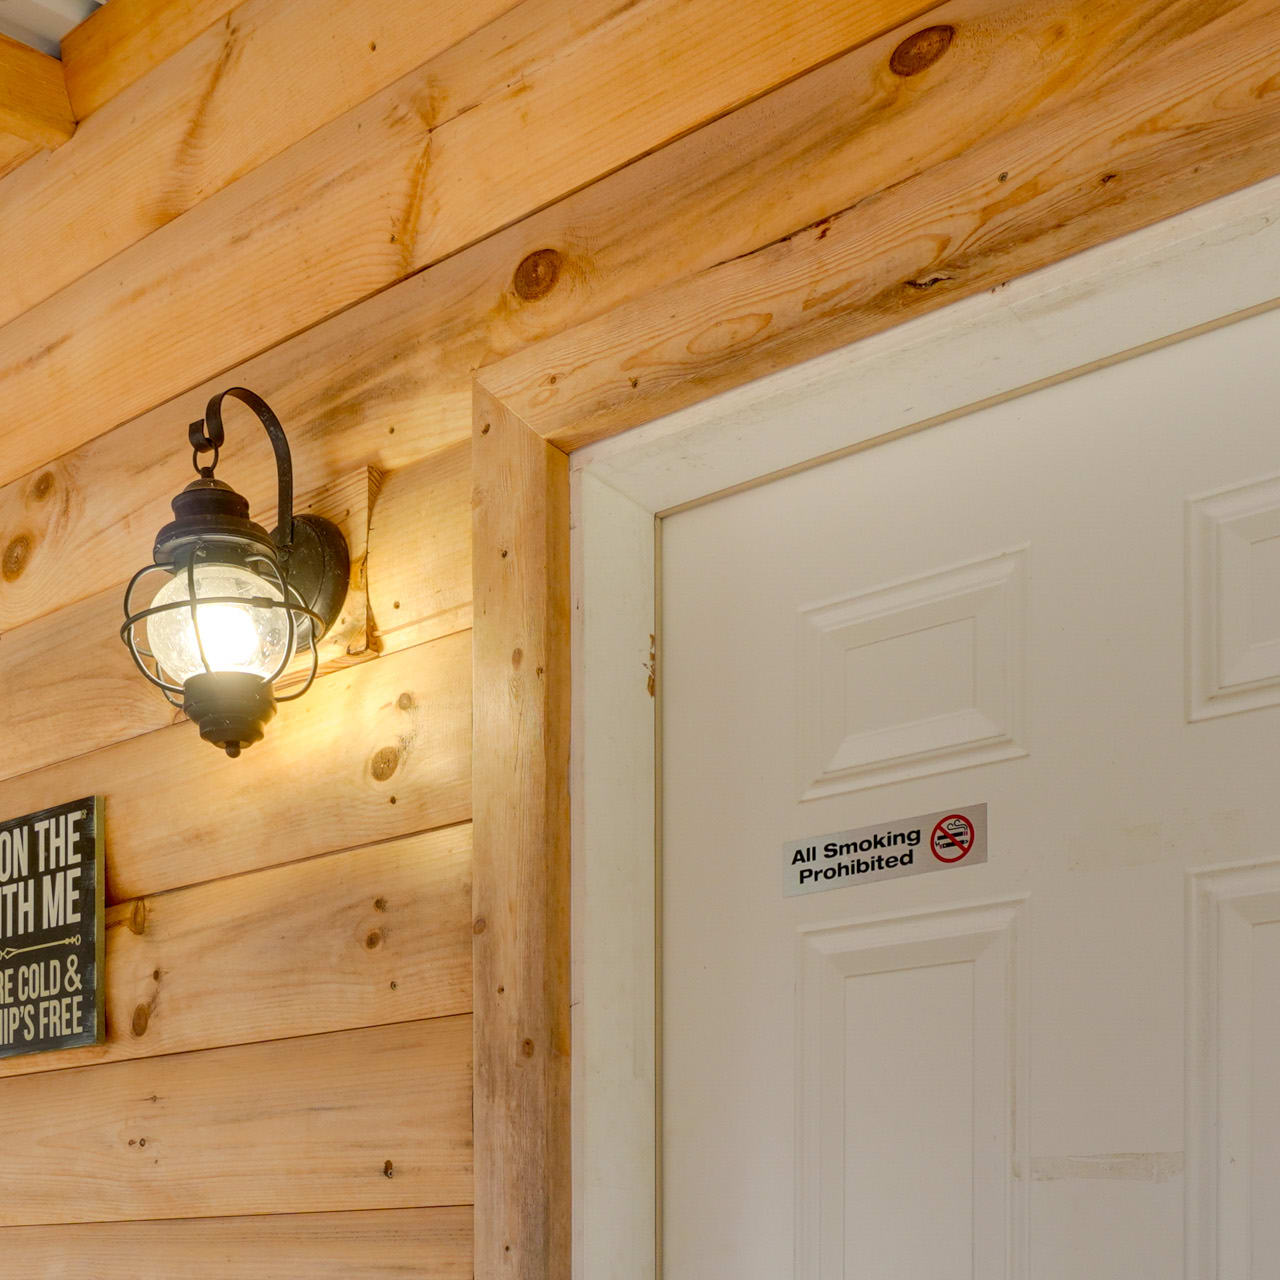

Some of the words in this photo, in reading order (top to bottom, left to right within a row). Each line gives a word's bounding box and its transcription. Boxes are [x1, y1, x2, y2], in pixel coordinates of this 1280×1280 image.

[34, 811, 82, 872] THE
[791, 846, 816, 865] All
[824, 829, 921, 859] Smoking
[799, 849, 914, 884] Prohibited
[42, 867, 81, 930] ME
[18, 959, 61, 1001] COLD
[64, 954, 83, 993] &
[39, 995, 83, 1040] FREE
